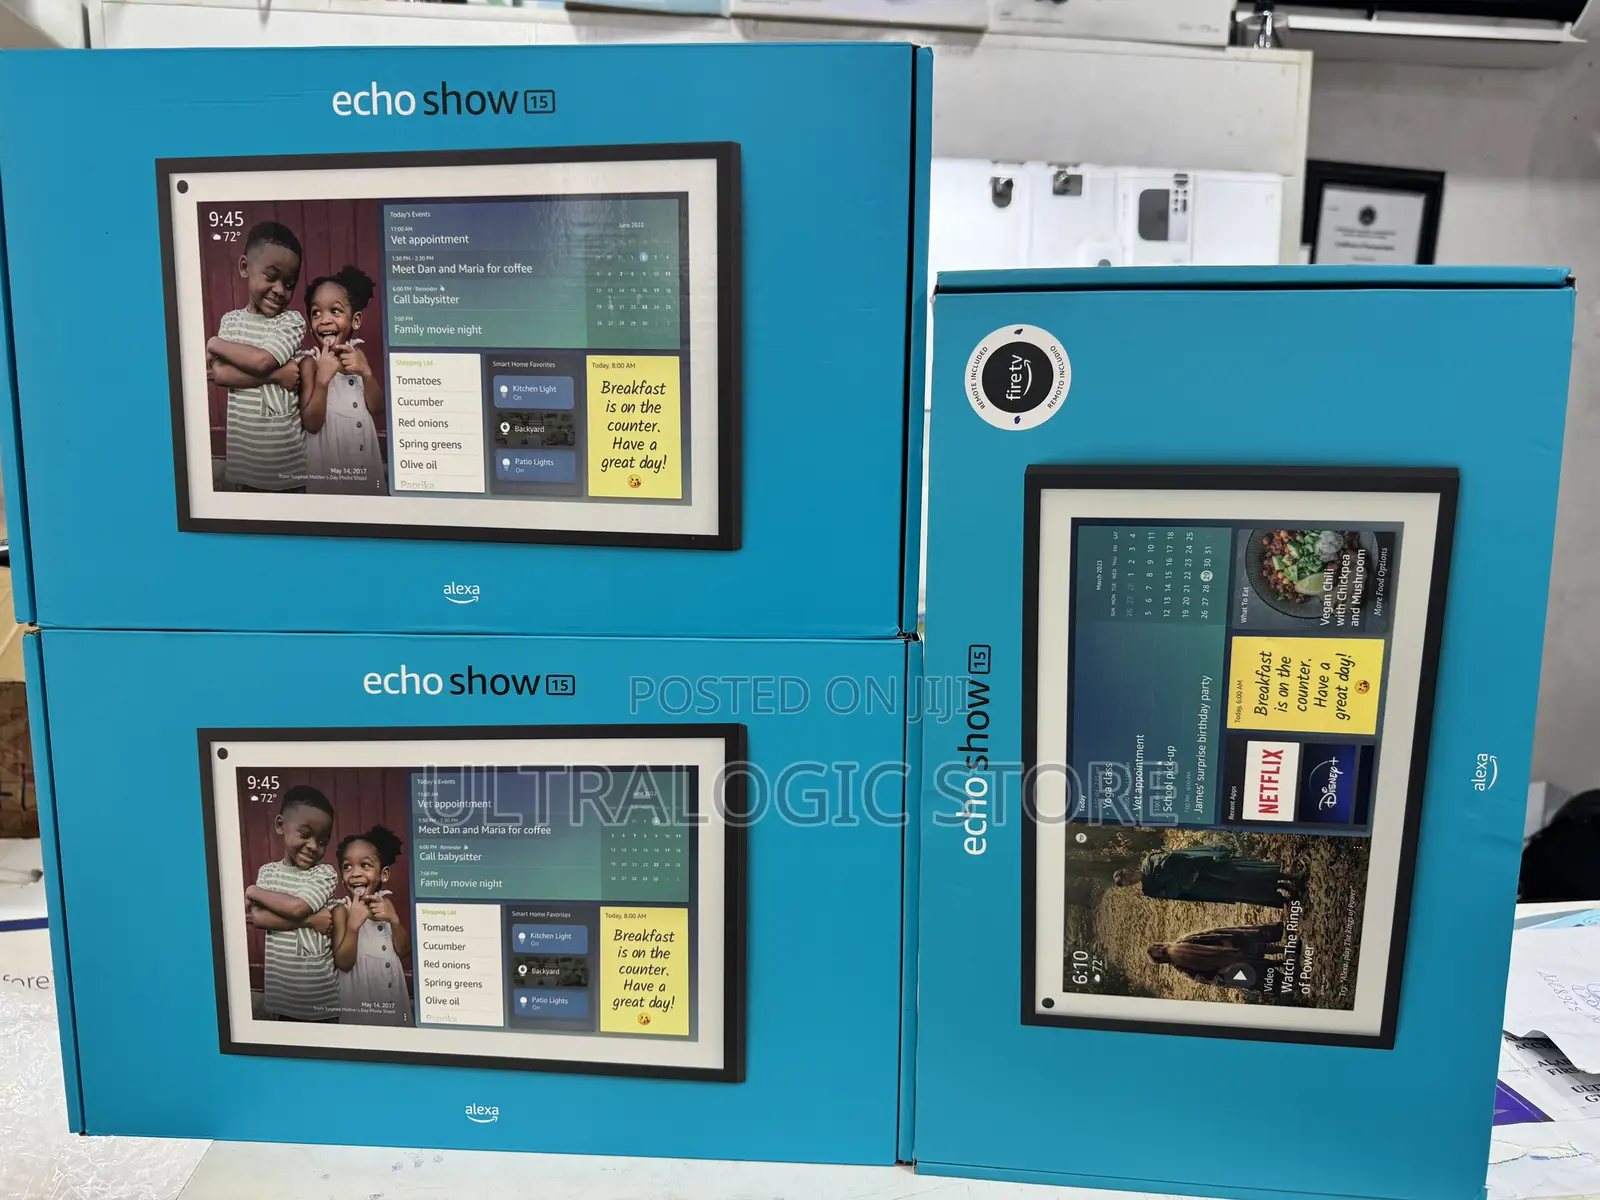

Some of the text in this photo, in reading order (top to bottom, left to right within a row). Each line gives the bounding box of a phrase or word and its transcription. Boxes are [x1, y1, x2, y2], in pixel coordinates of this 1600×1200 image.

[333, 82, 548, 115] echo show 15
[209, 211, 243, 227] 9:45
[223, 232, 241, 241] 72°
[391, 235, 469, 246] Vet appointment
[392, 263, 532, 274] Meet Dan and Maria for coffee
[393, 295, 459, 306] Call babysitter
[394, 324, 482, 336] Family movie night
[397, 376, 441, 385] Tomatoes
[971, 346, 988, 410] REMOTE INCLUDED
[1047, 345, 1065, 409] REMOTO INCLUIDO
[513, 385, 556, 394] Kitchen Light
[601, 380, 666, 395] Breakfast
[398, 398, 444, 406] Cucumber
[606, 399, 661, 414] is on the
[398, 418, 448, 428] Red onions
[608, 420, 660, 433] counter.
[515, 426, 544, 434] Backyard
[399, 440, 462, 451] Spring greens
[613, 437, 657, 450] Have a
[400, 460, 437, 469] Olive oil
[534, 459, 554, 467] Lights
[601, 455, 667, 473] great day!
[444, 581, 480, 594] alexa
[1350, 549, 1365, 626] and Mushroom
[1374, 548, 1388, 616] More Food Options
[1336, 554, 1350, 626] with Chickpea
[1242, 598, 1248, 606] To
[1320, 569, 1334, 626] Vegan Chili
[364, 665, 568, 695] echo show 15
[1237, 680, 1243, 690] AM
[1254, 651, 1272, 716] Breakfast
[1274, 656, 1291, 712] is on the
[1297, 658, 1311, 712] counter.
[1335, 653, 1355, 720] great day!
[1314, 675, 1329, 707] Have
[1235, 705, 1243, 723] Today,
[1194, 675, 1212, 813] James' surprise birthday party
[956, 652, 990, 855] echo show 15
[1133, 735, 1144, 810] Vet appointment
[1163, 746, 1176, 811] School pick-up
[1471, 753, 1488, 791] alexa
[248, 776, 280, 789] 9:45
[1103, 763, 1114, 808] Yoga class
[1258, 749, 1284, 814] NETFLIX
[260, 794, 277, 802] 72°
[418, 800, 492, 809] Vet appointment
[419, 825, 551, 834] Meet Dan and Maria for coffee
[420, 852, 482, 862] Call babysitter
[420, 878, 502, 889] Family movie night
[422, 923, 464, 932] Tomatoes
[614, 929, 675, 943] Breakfast
[423, 942, 466, 950] Cucumber
[618, 946, 670, 959] is on the
[1281, 900, 1302, 993] Watch The Rings
[442, 961, 470, 969] onions
[619, 964, 669, 976] counter.
[1072, 951, 1088, 984] 6:10
[1092, 955, 1102, 972] 72°
[1299, 945, 1314, 994] of Power
[425, 978, 482, 989] Spring greens
[623, 980, 666, 991] Have a
[1264, 968, 1274, 992] Video
[426, 997, 447, 1005] Olive
[613, 995, 675, 1012] great day!
[466, 1103, 499, 1115] alexa
